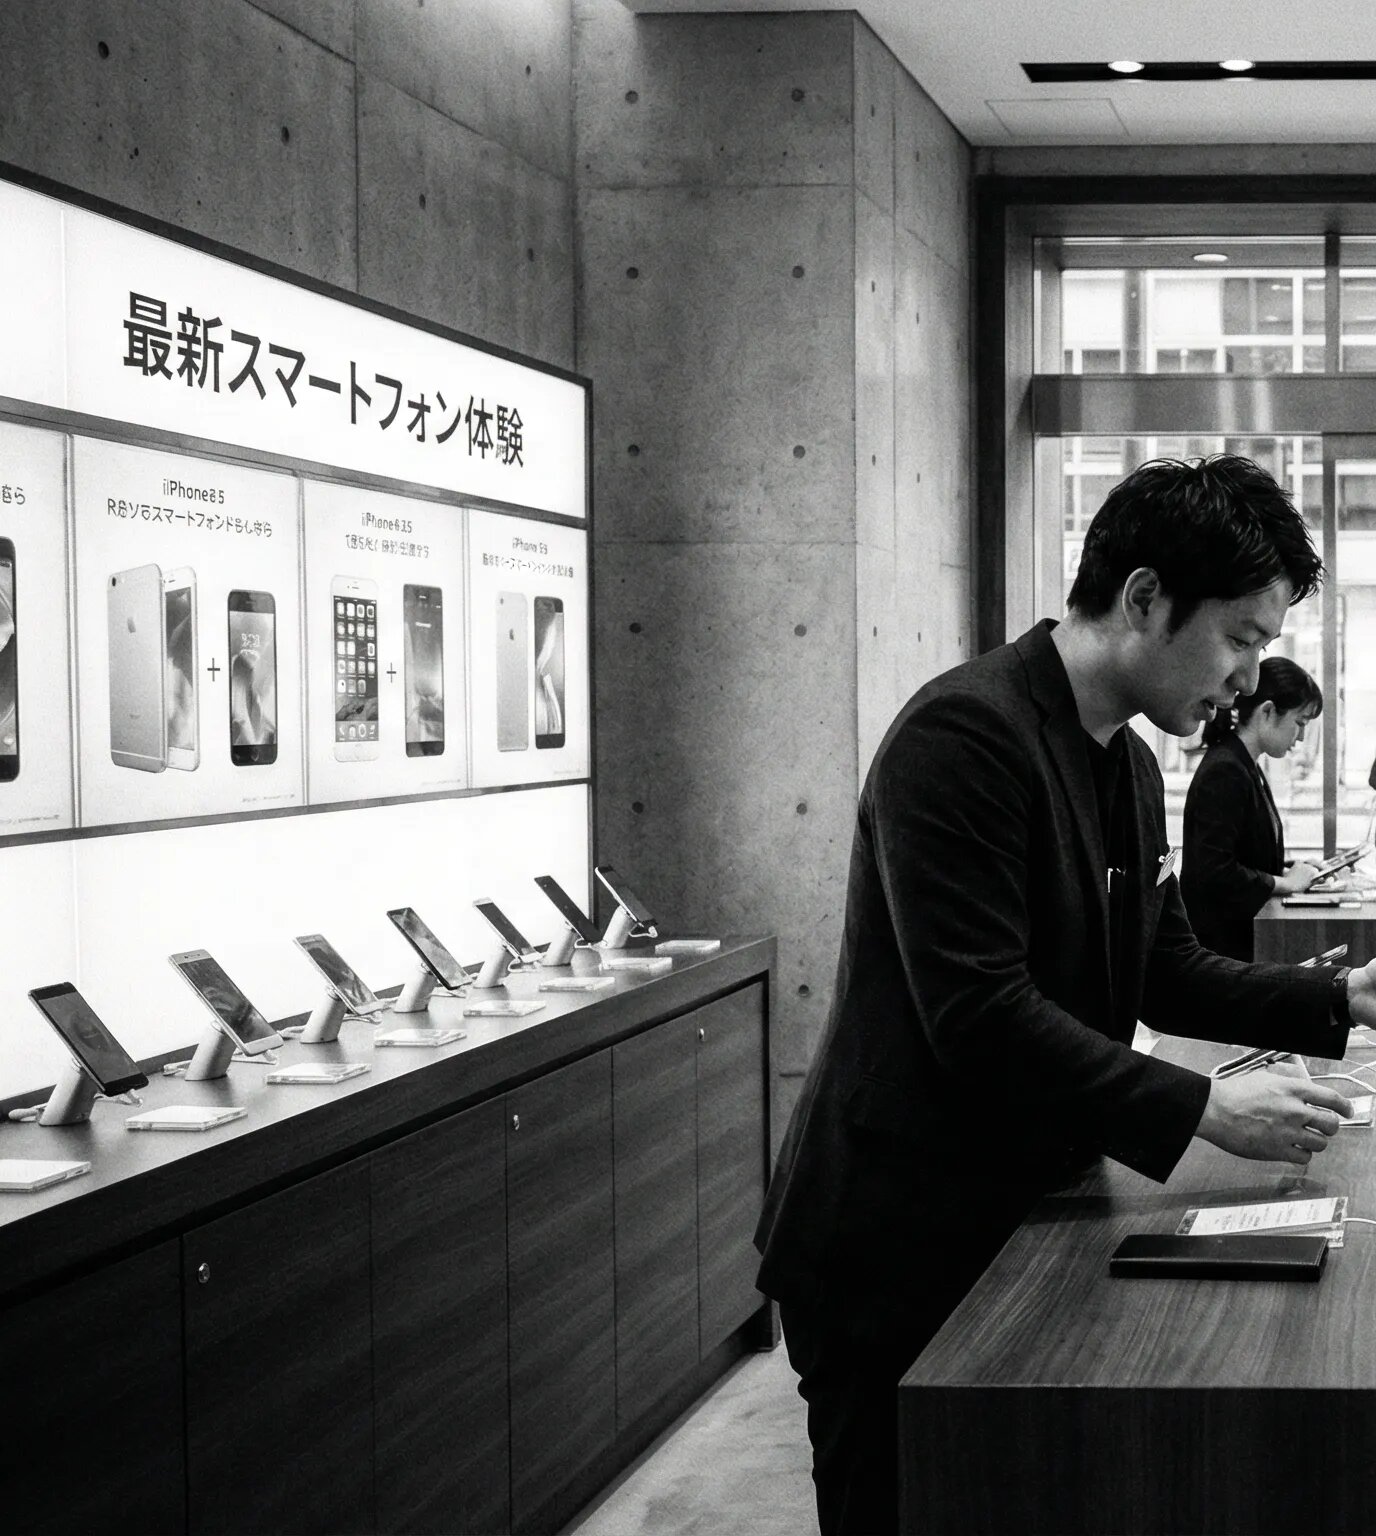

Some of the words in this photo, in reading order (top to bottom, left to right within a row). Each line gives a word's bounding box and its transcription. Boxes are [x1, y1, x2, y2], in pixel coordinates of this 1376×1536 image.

[122, 291, 525, 469] 最新スマートフォン体験
